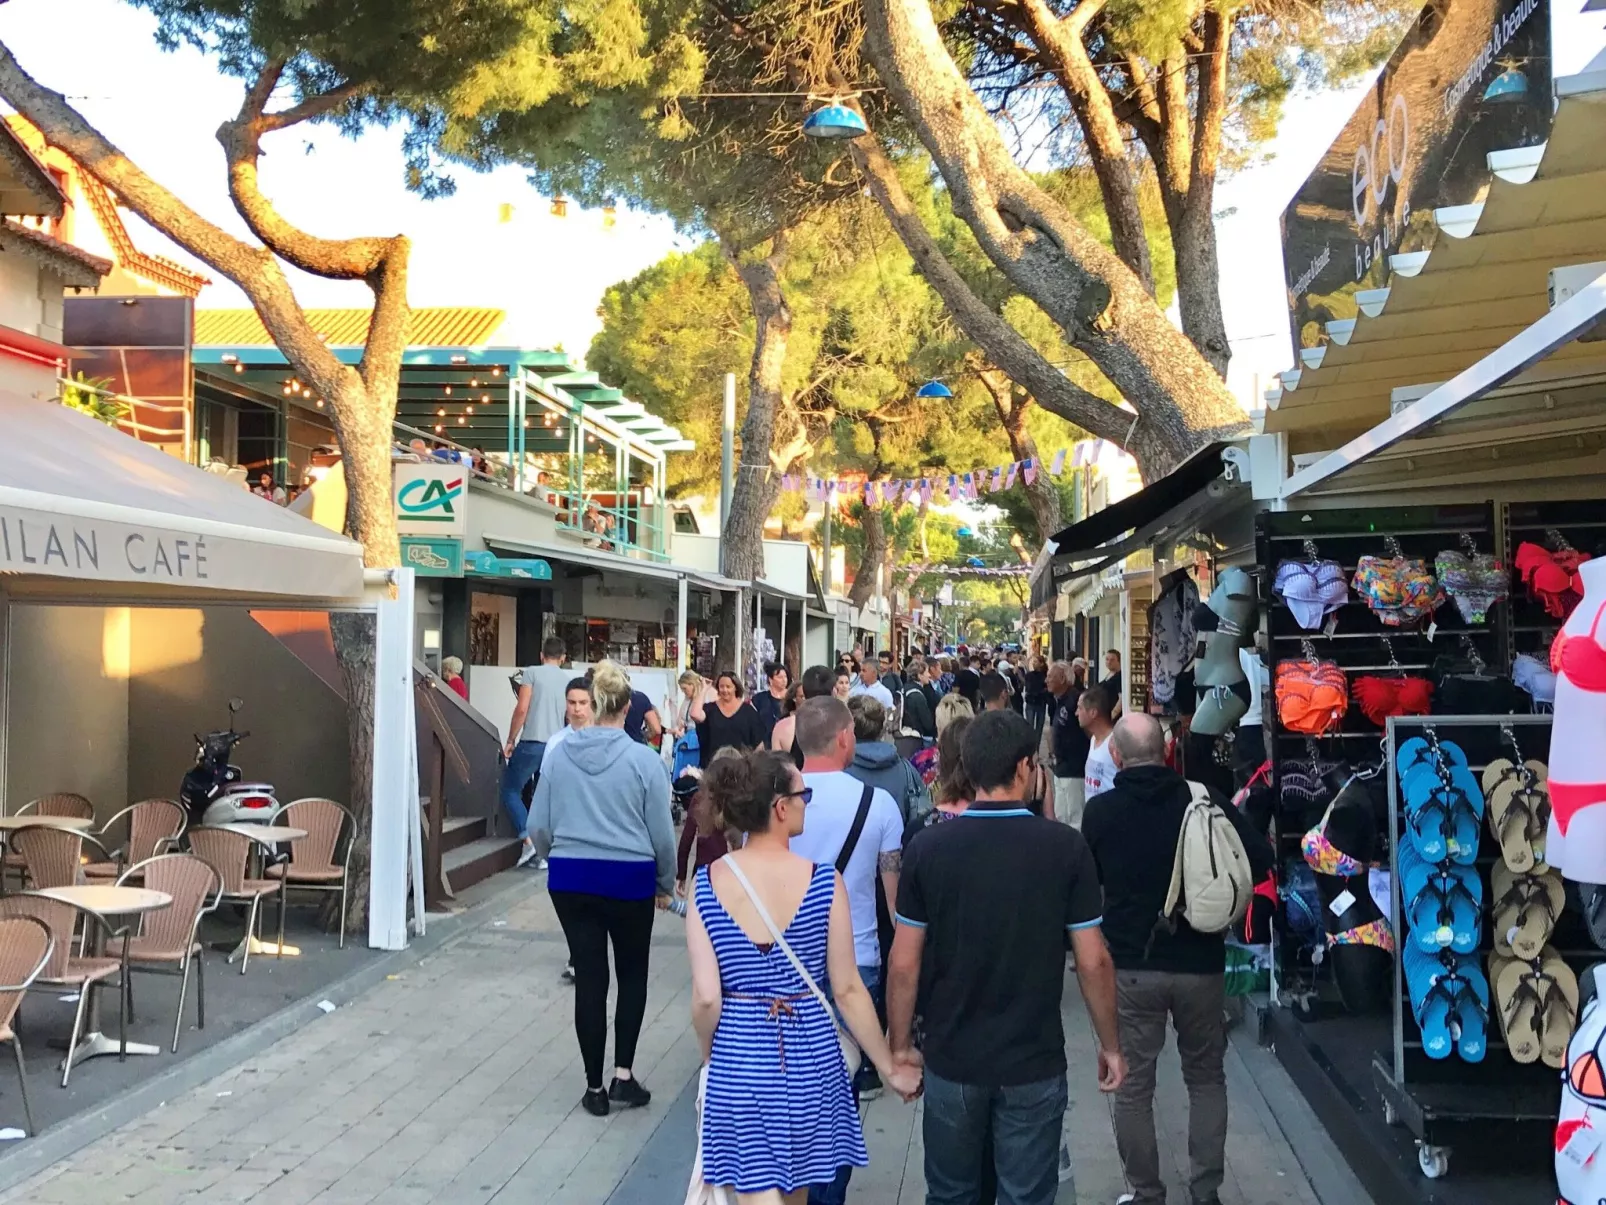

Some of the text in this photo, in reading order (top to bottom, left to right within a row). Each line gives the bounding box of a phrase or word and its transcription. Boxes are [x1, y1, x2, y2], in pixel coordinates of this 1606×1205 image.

[1493, 23, 1503, 55] &
[1353, 94, 1408, 227] eco
[1, 516, 208, 579] ILAN CAFÉ
